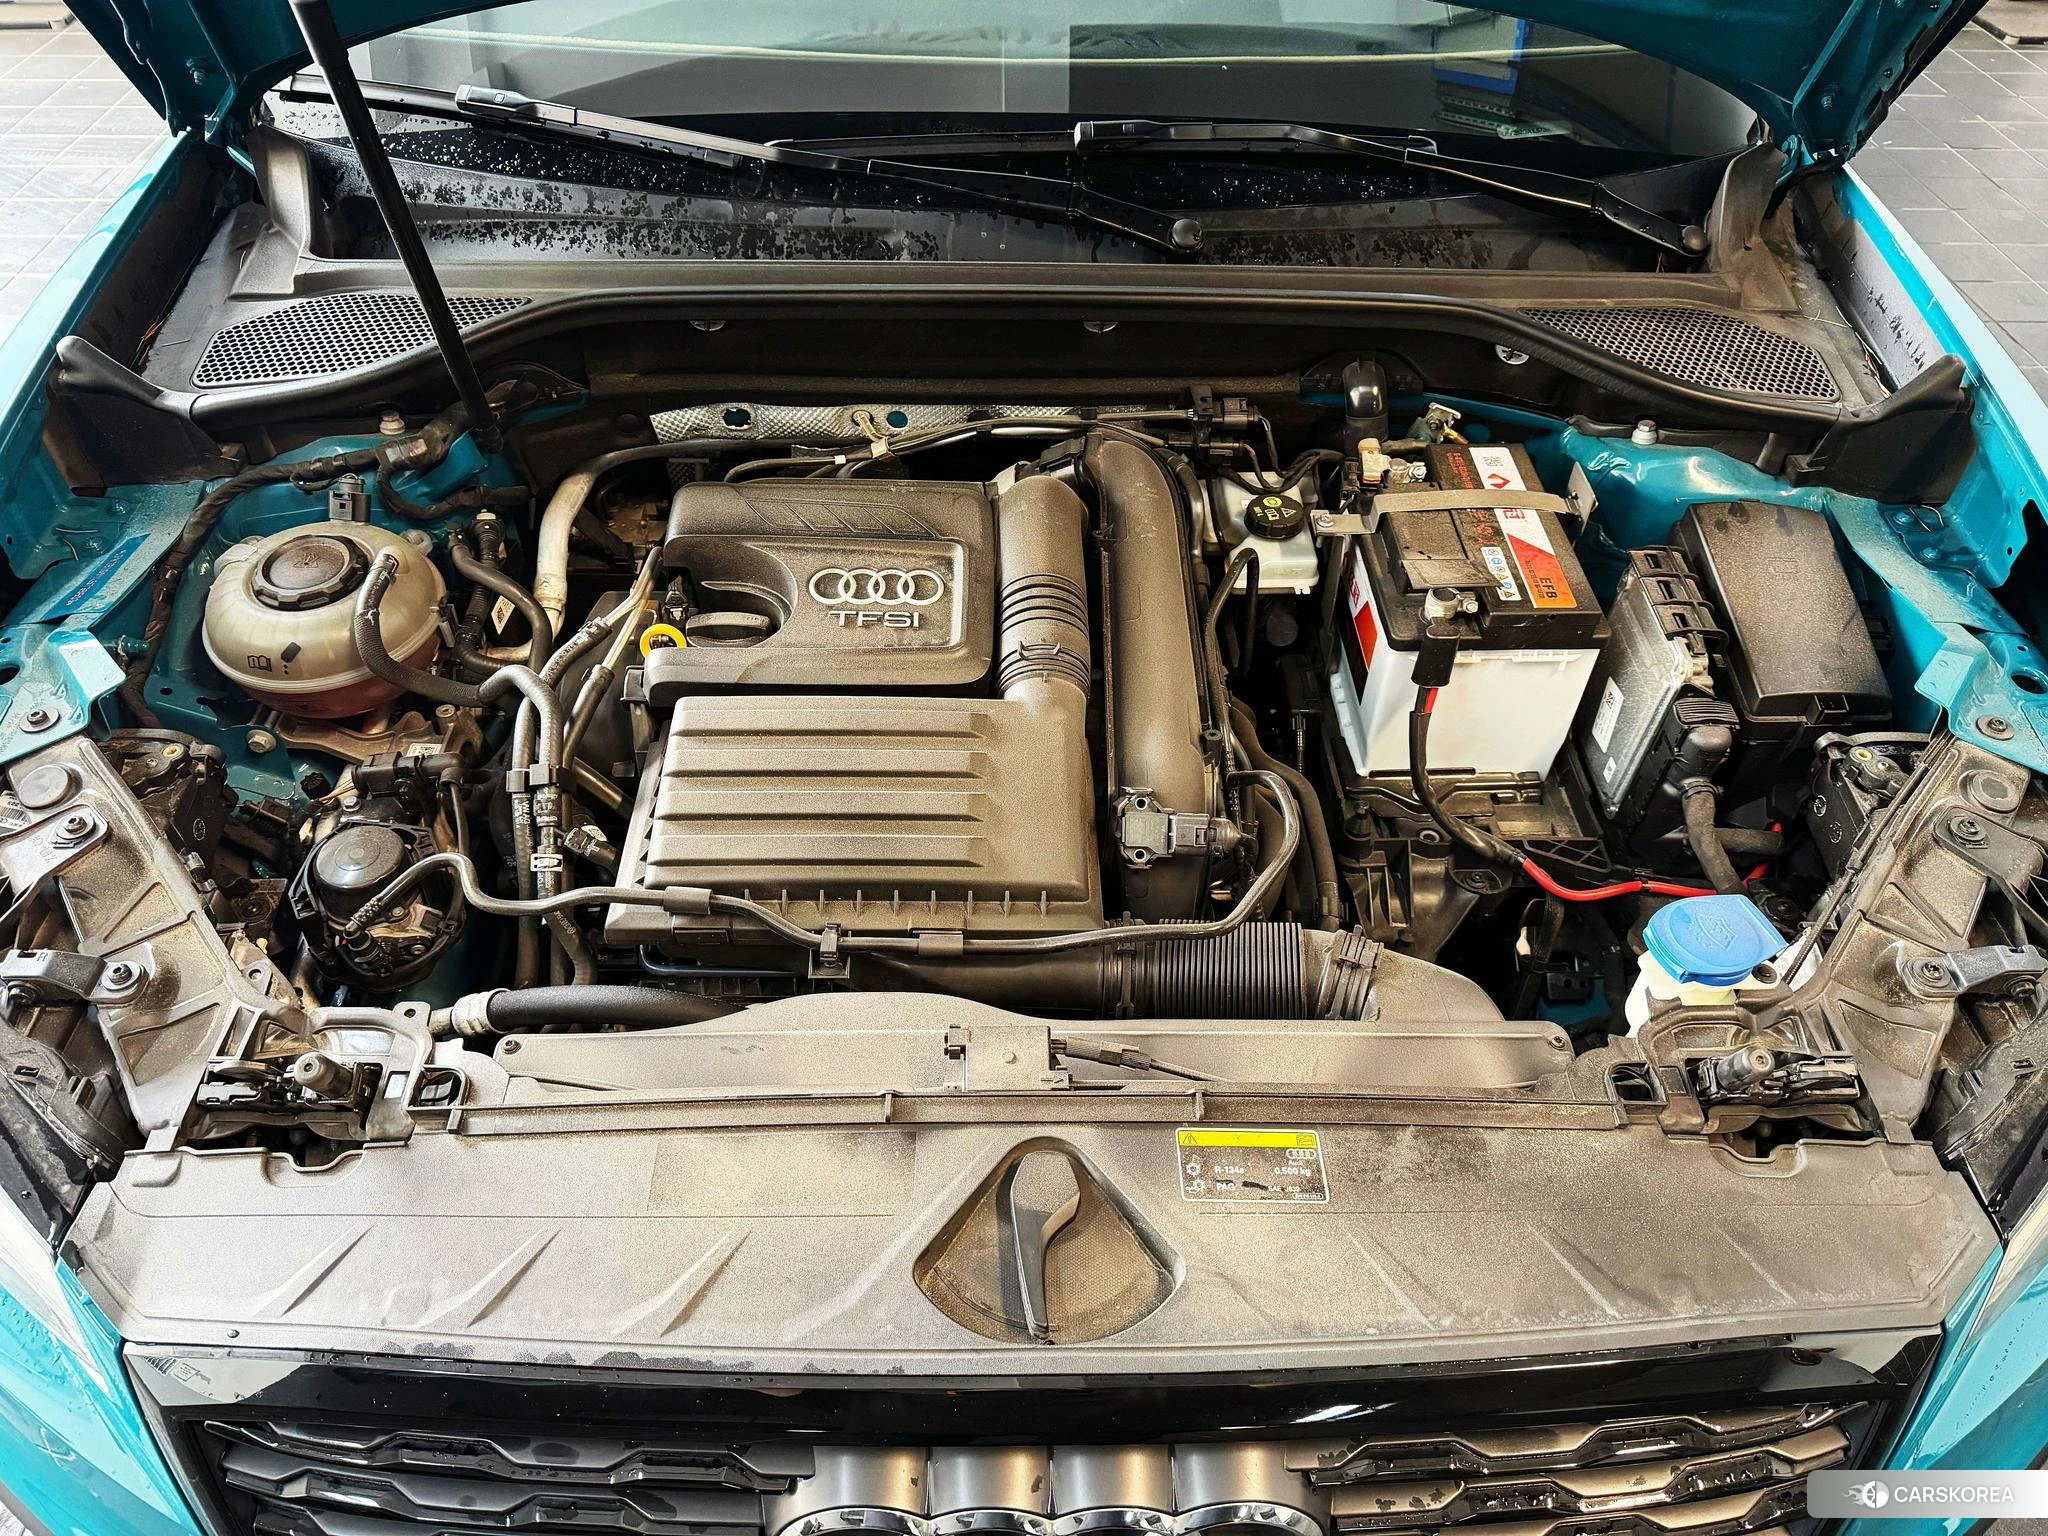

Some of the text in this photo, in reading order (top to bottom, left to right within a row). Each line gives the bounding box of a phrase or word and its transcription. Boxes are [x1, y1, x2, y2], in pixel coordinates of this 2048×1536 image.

[1540, 577, 1558, 599] EFB
[829, 610, 920, 628] TFSI
[1214, 1165, 1311, 1176] R-134a 0,500 kg
[1216, 1182, 1236, 1191] PAG
